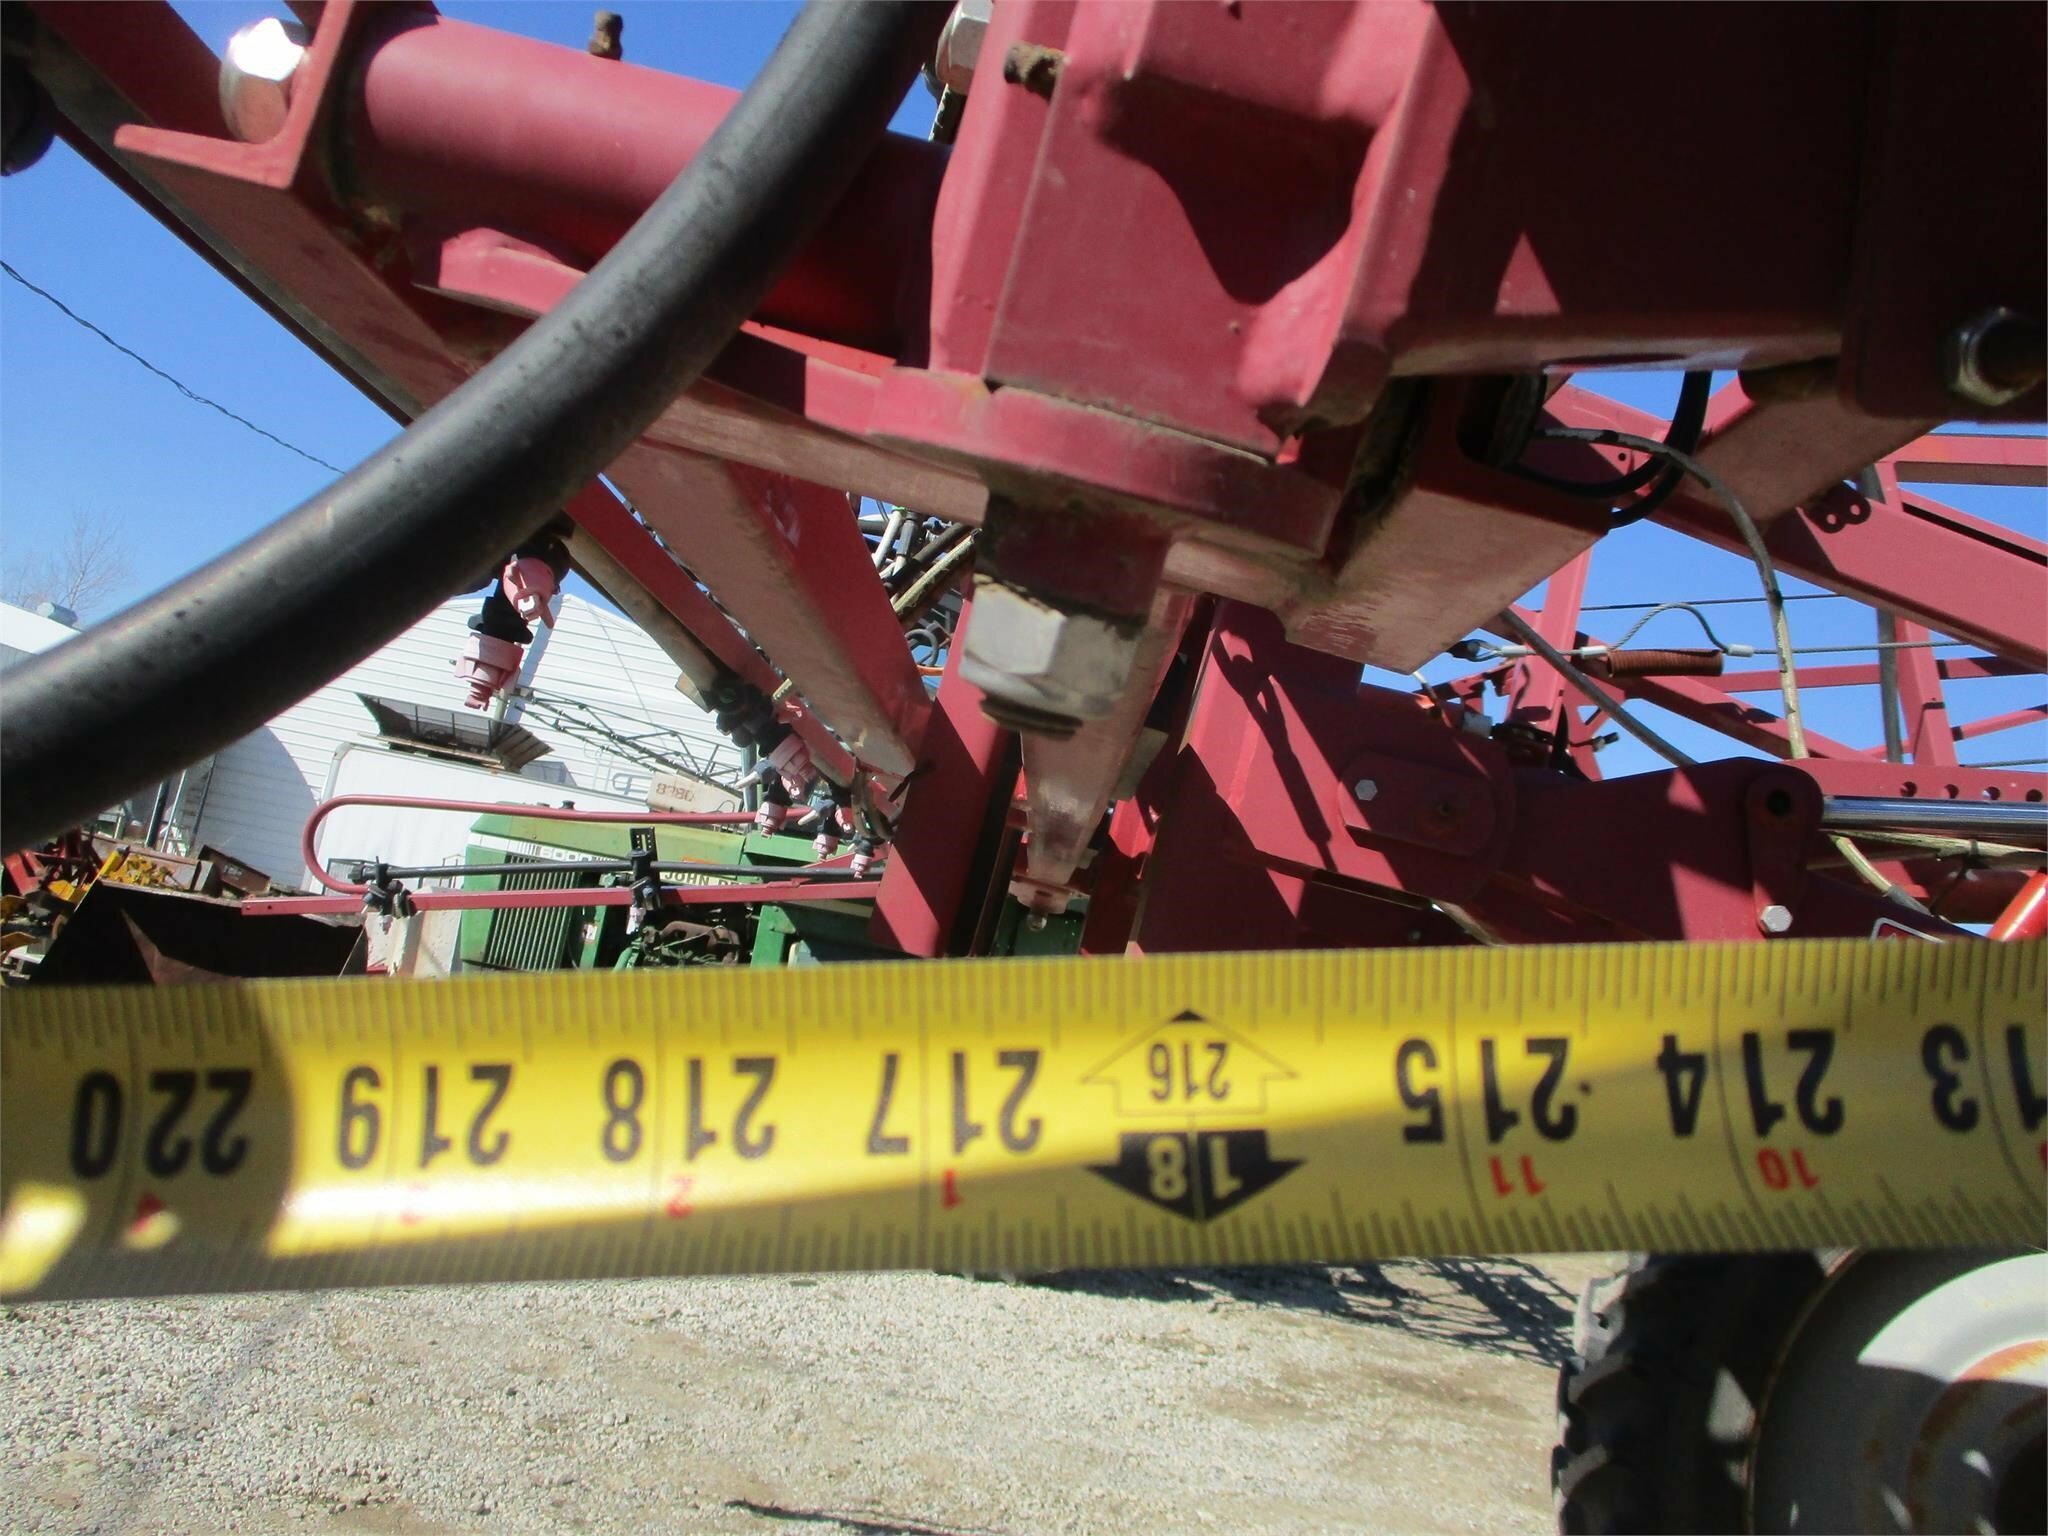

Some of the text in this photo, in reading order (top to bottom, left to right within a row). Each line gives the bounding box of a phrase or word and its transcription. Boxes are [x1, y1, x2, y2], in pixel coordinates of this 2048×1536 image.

[664, 871, 710, 886] JOHN
[70, 1068, 253, 1180] 220
[335, 1064, 513, 1169] 219
[600, 1057, 777, 1163] 218
[866, 1049, 1043, 1154] 217
[1149, 1041, 1229, 1102] 216
[1396, 1037, 1578, 1143] 215
[1657, 1029, 1845, 1138] 214
[1921, 1023, 2048, 1133] 13
[941, 1169, 964, 1210] 1
[1147, 1135, 1243, 1199] 18
[1488, 1155, 1547, 1197] 11
[1757, 1147, 1819, 1192] 10
